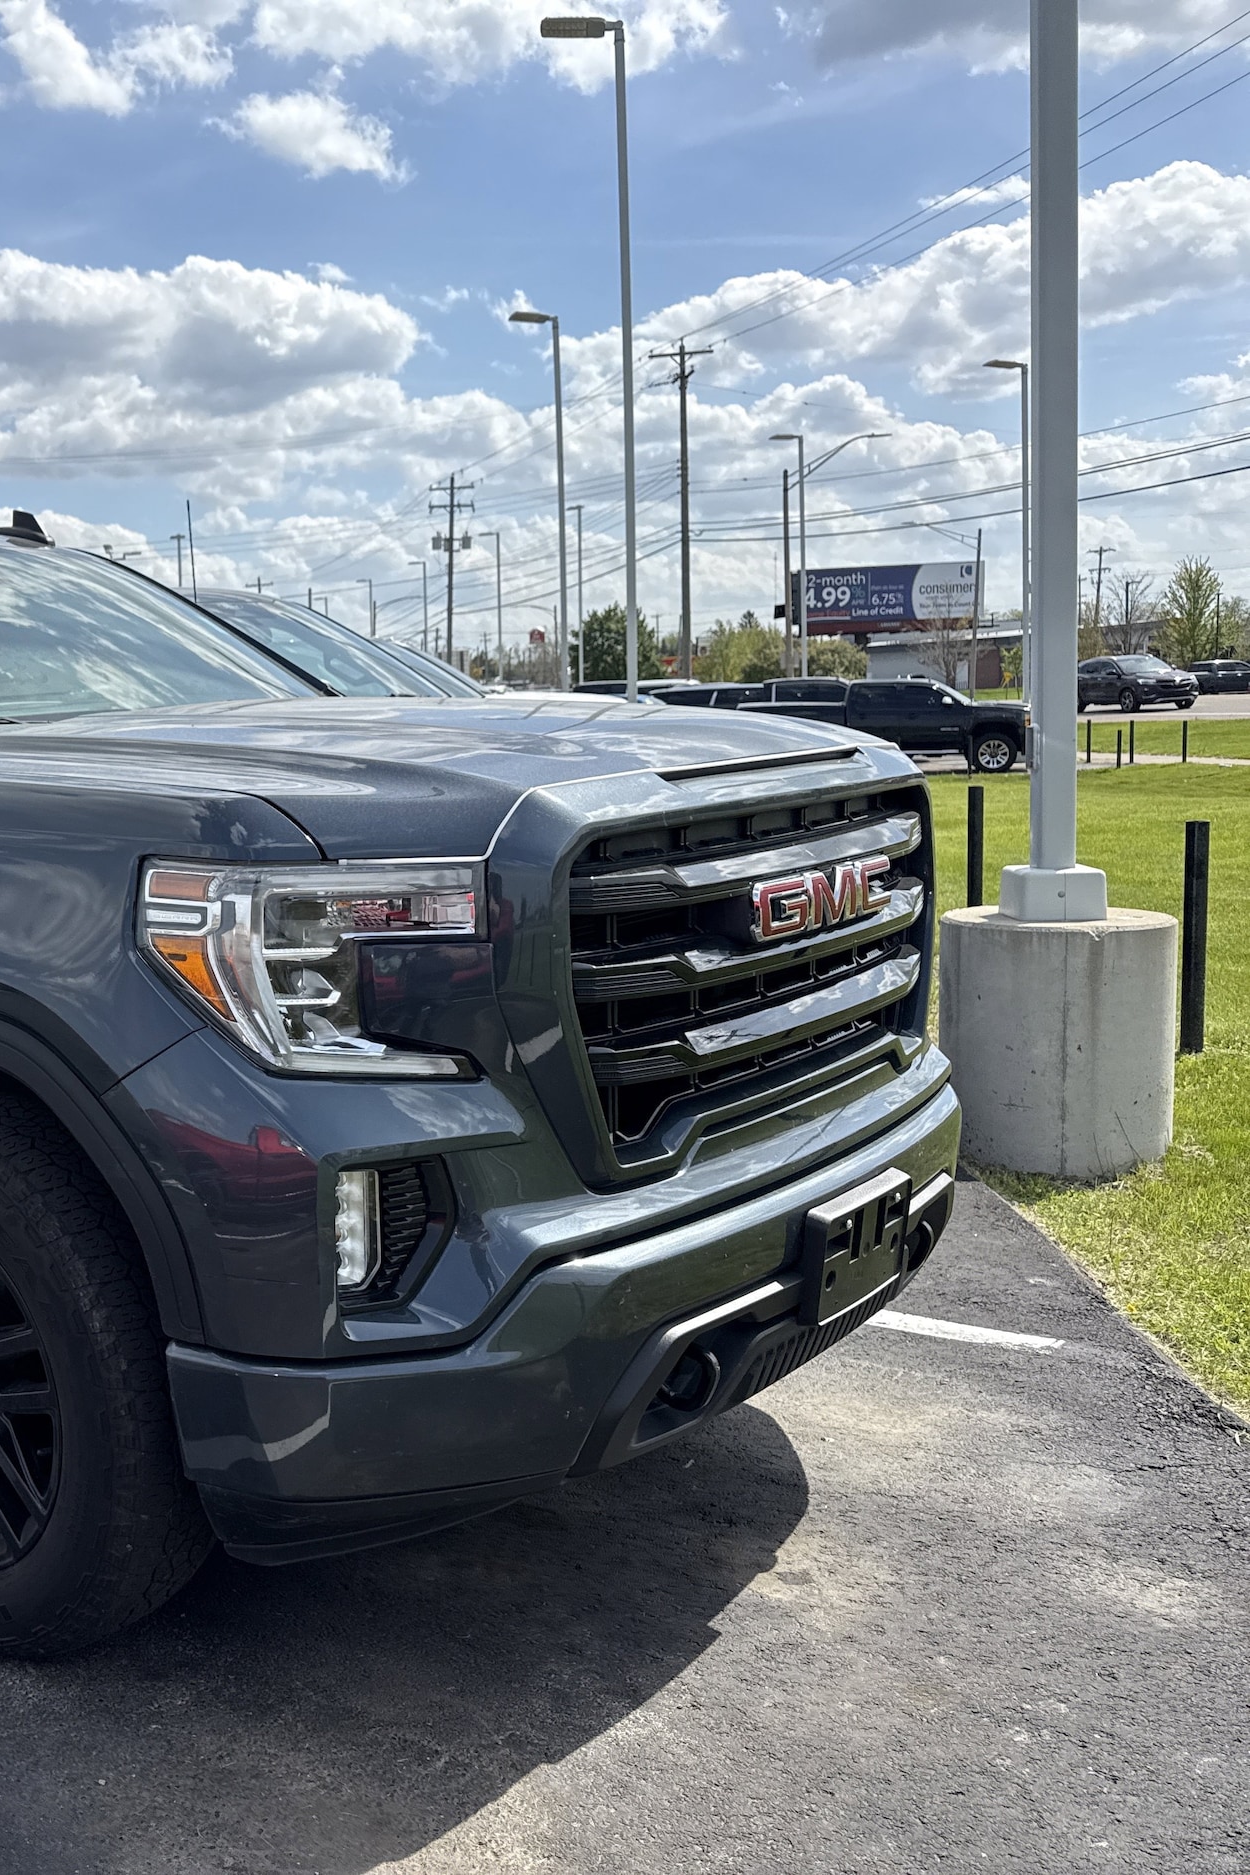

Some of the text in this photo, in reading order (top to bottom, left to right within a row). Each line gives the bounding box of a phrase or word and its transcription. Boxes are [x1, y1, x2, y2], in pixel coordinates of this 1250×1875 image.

[805, 586, 851, 608] 4.99
[919, 583, 978, 595] consumer
[852, 606, 904, 617] Line of Credit
[752, 854, 892, 942] GMC
